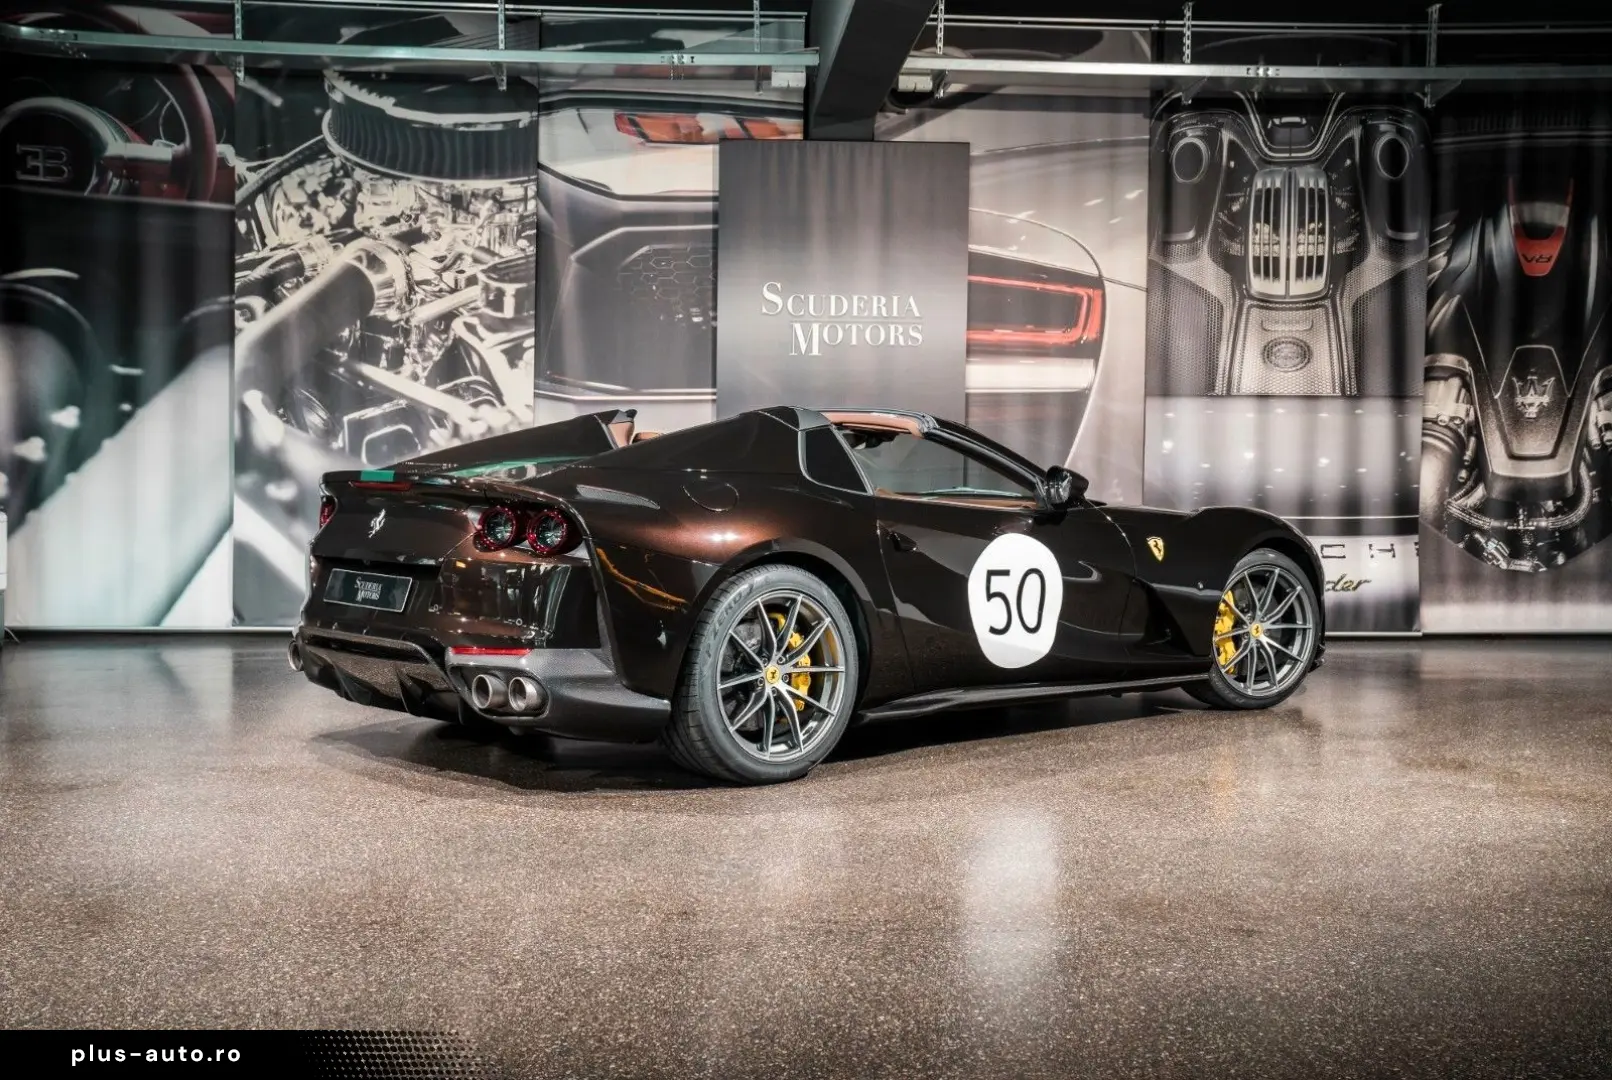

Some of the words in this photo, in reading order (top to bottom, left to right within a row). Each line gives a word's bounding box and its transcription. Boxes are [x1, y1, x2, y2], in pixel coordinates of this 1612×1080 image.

[761, 281, 922, 317] SCUDERIA
[789, 322, 923, 356] MOTORS
[985, 567, 1046, 636] 50
